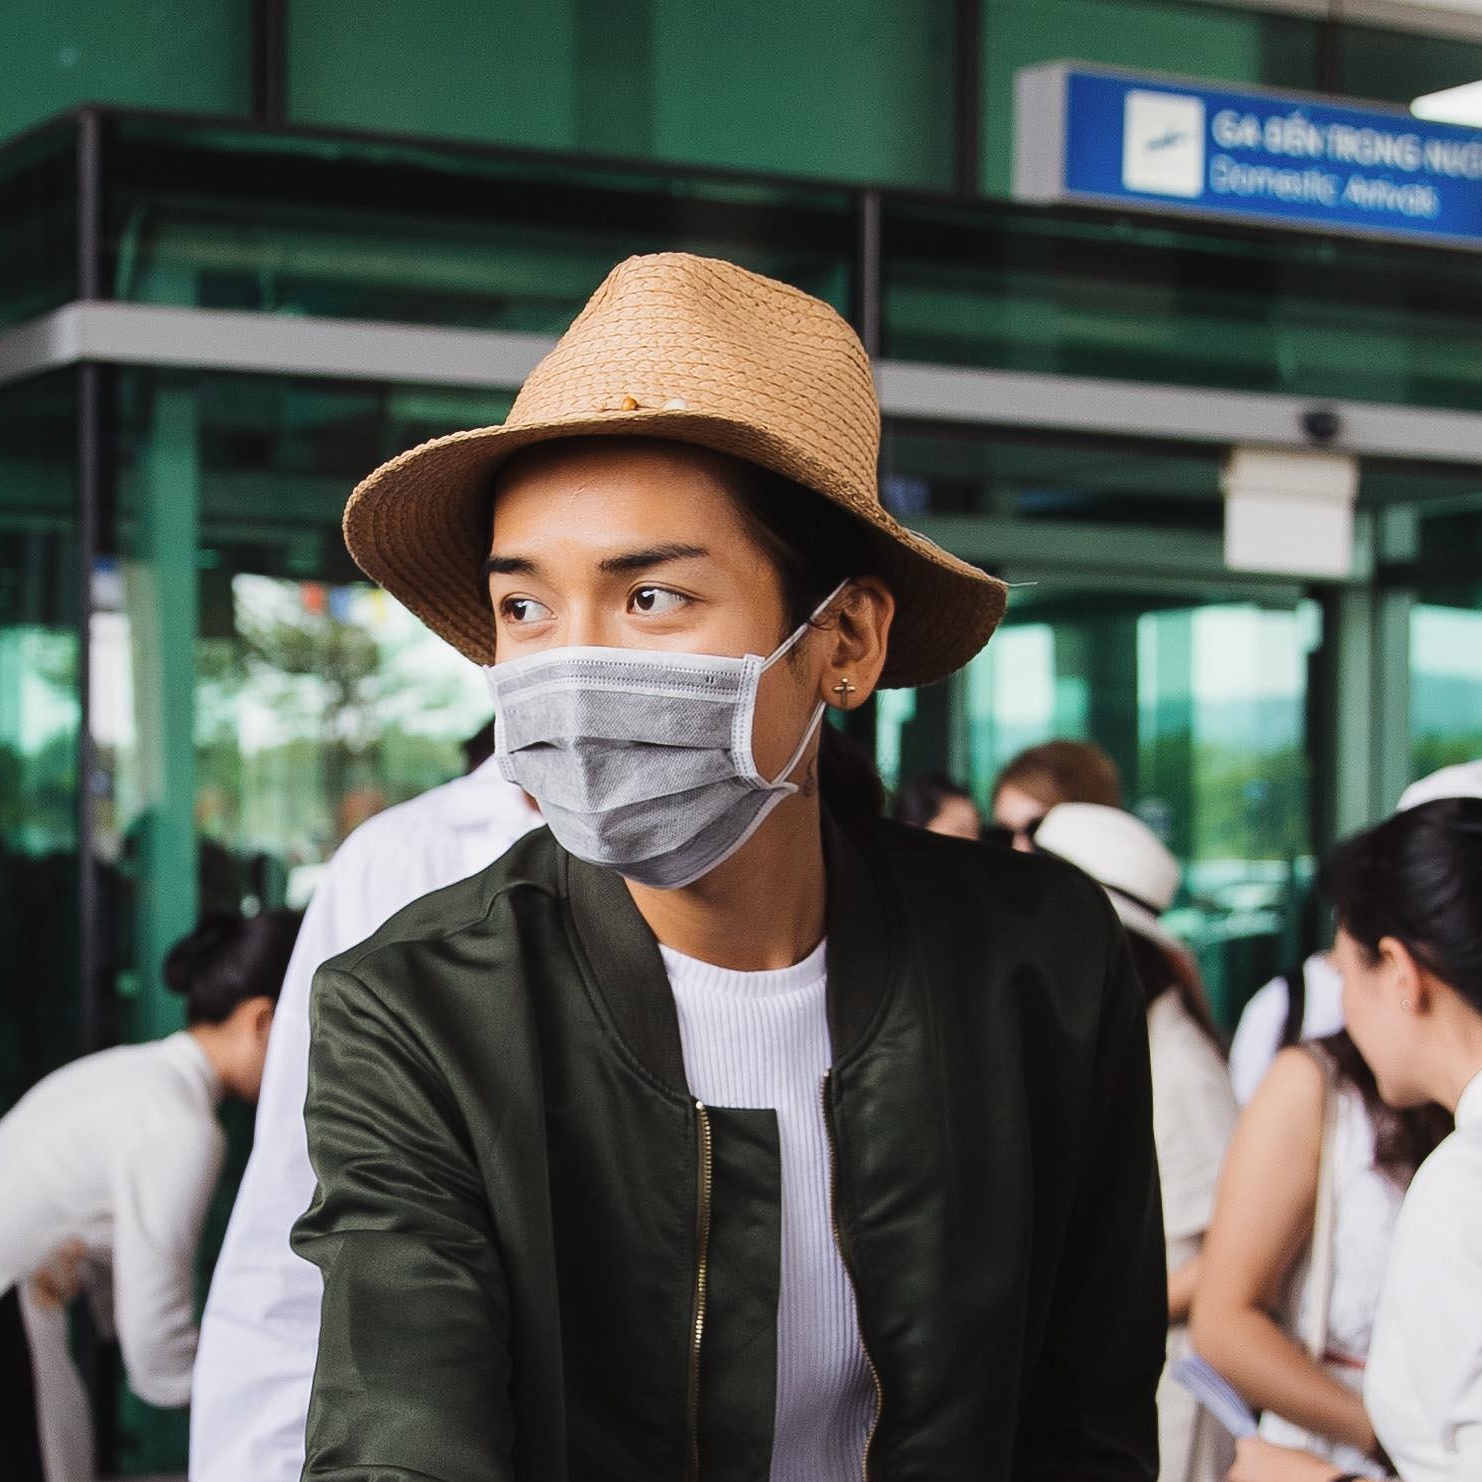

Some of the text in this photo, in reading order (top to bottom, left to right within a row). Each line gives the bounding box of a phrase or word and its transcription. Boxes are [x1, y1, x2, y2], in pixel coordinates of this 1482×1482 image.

[1211, 109, 1261, 149] GA
[1326, 122, 1423, 172] TRONG
[1209, 154, 1343, 207] Domestic
